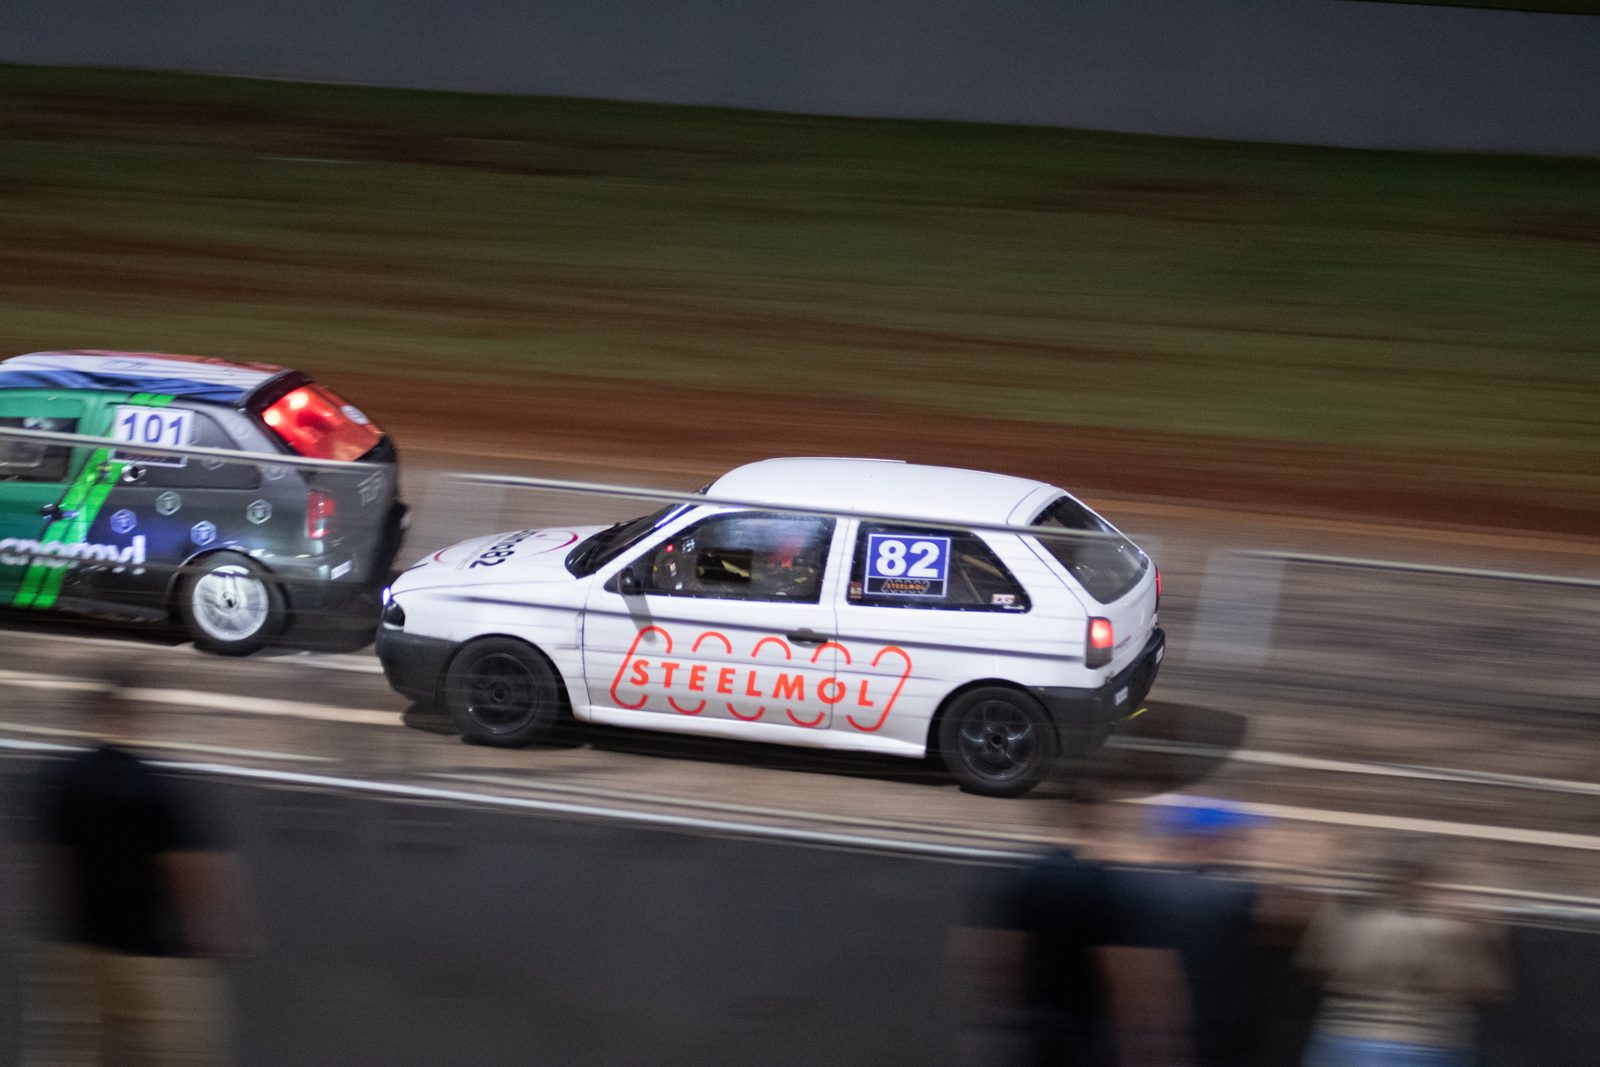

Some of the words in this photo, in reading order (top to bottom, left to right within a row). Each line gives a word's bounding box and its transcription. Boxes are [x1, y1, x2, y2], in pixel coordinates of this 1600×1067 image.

[122, 412, 184, 446] 101
[876, 539, 940, 578] 82
[629, 659, 874, 707] STEELMOL
